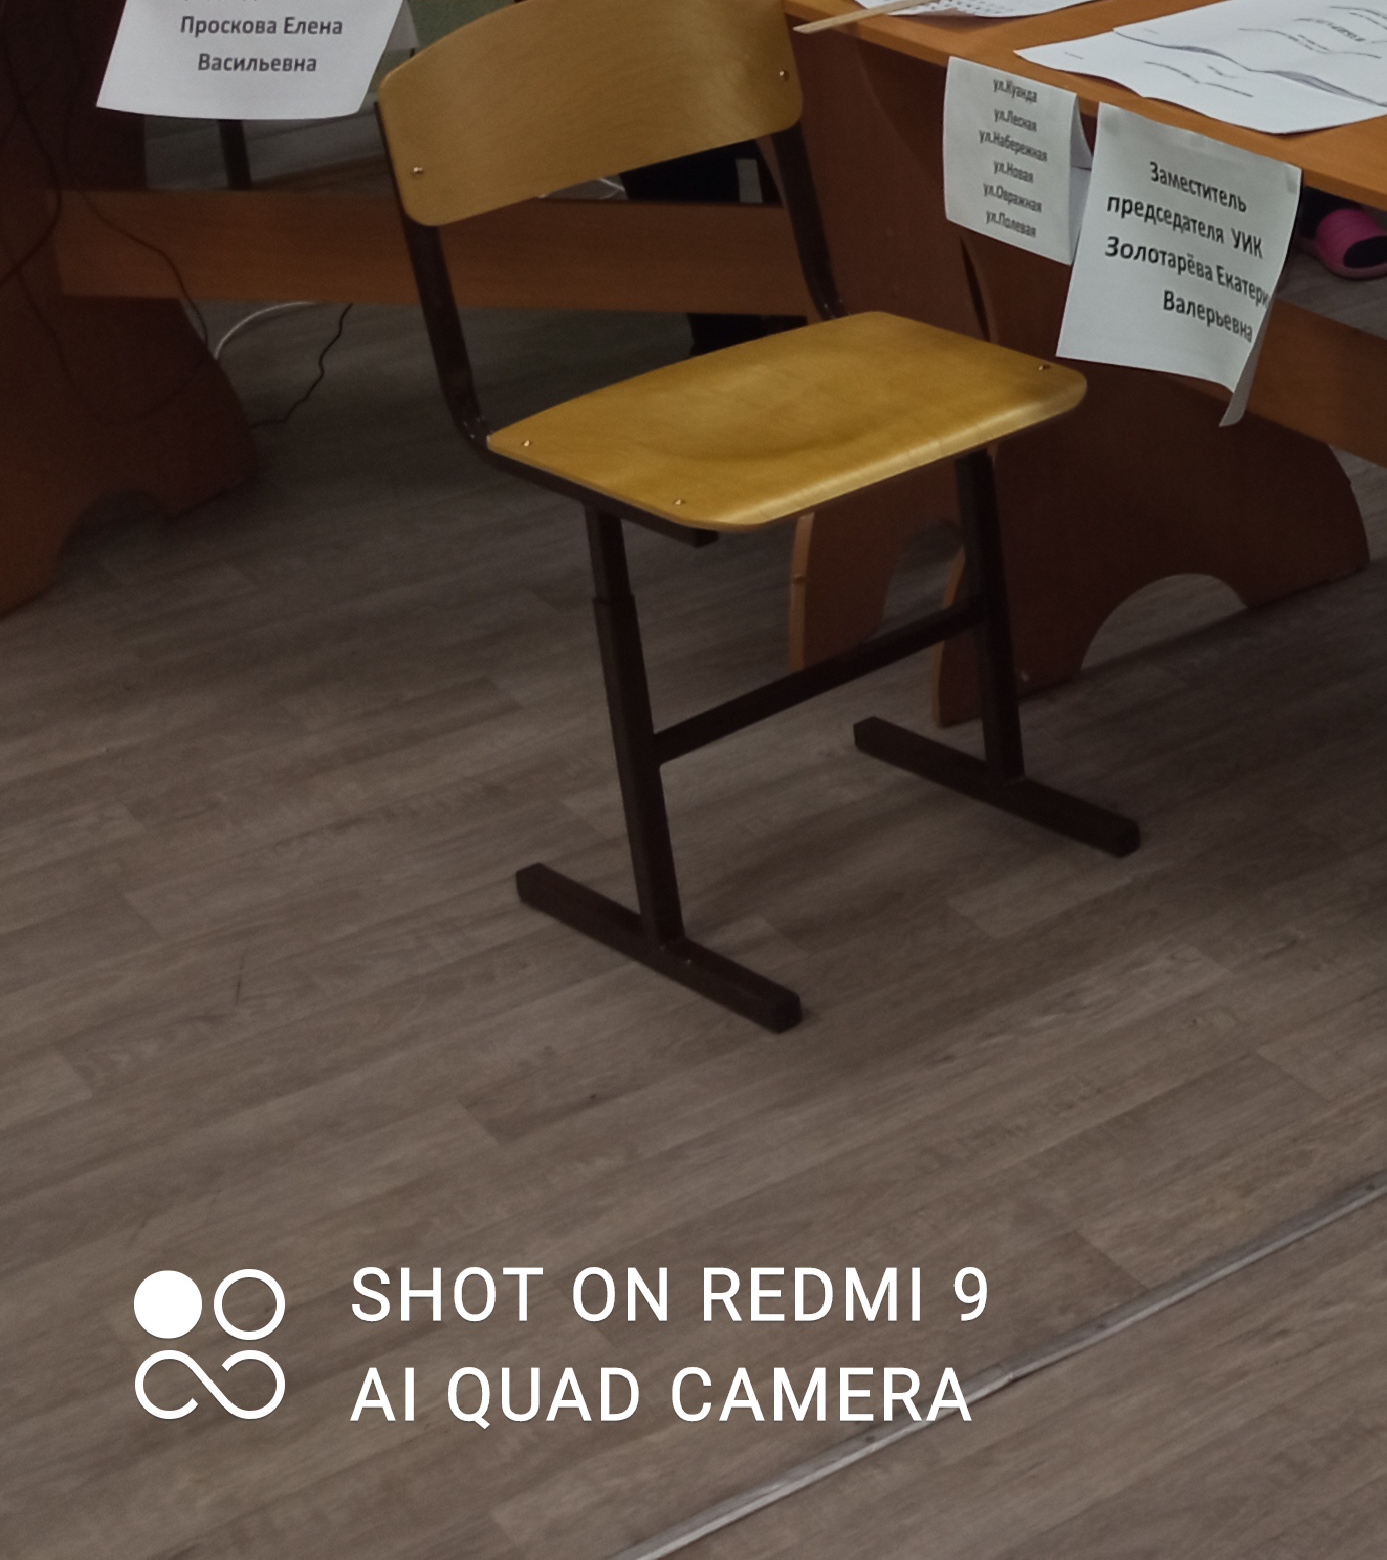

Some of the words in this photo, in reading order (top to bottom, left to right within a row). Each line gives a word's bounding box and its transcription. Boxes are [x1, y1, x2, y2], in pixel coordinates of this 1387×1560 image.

[180, 15, 277, 38] Проскова
[283, 16, 343, 35] Елена
[197, 52, 317, 72] Васильевна
[994, 108, 1037, 132] ул.Лесная
[979, 129, 1048, 162] ул.Набережная
[993, 159, 1034, 183] ул.Новая
[983, 183, 1042, 213] ул.Овражная
[1149, 161, 1248, 213] Заместитель
[986, 210, 1037, 238] ул.Полевая
[1106, 196, 1225, 245] председателя
[1230, 227, 1263, 259] УИК
[1104, 235, 1214, 282] Золотарёва
[1163, 289, 1253, 344] Валерьевна
